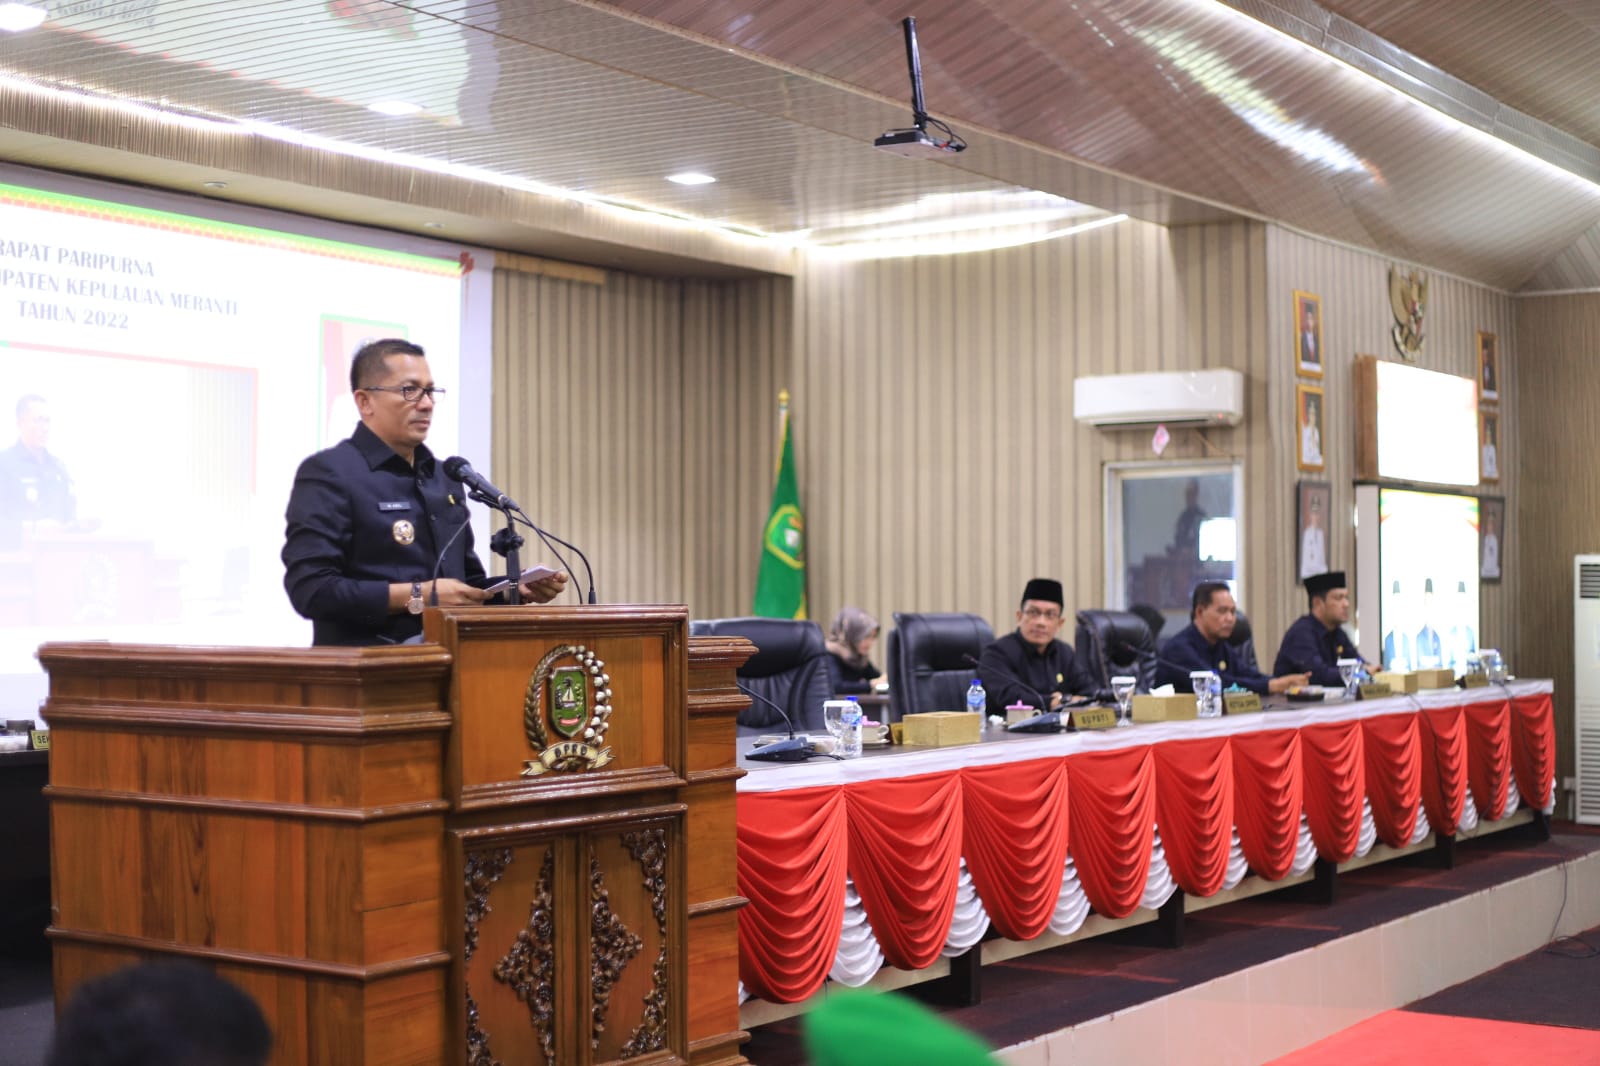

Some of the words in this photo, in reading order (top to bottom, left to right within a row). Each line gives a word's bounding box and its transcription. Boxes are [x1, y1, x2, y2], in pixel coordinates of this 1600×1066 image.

[57, 247, 154, 277] PARIPURNA
[66, 277, 163, 306] KEPULAUAN
[170, 292, 239, 316] MERANTI
[17, 300, 77, 324] TAHUN
[83, 308, 129, 330] 2022
